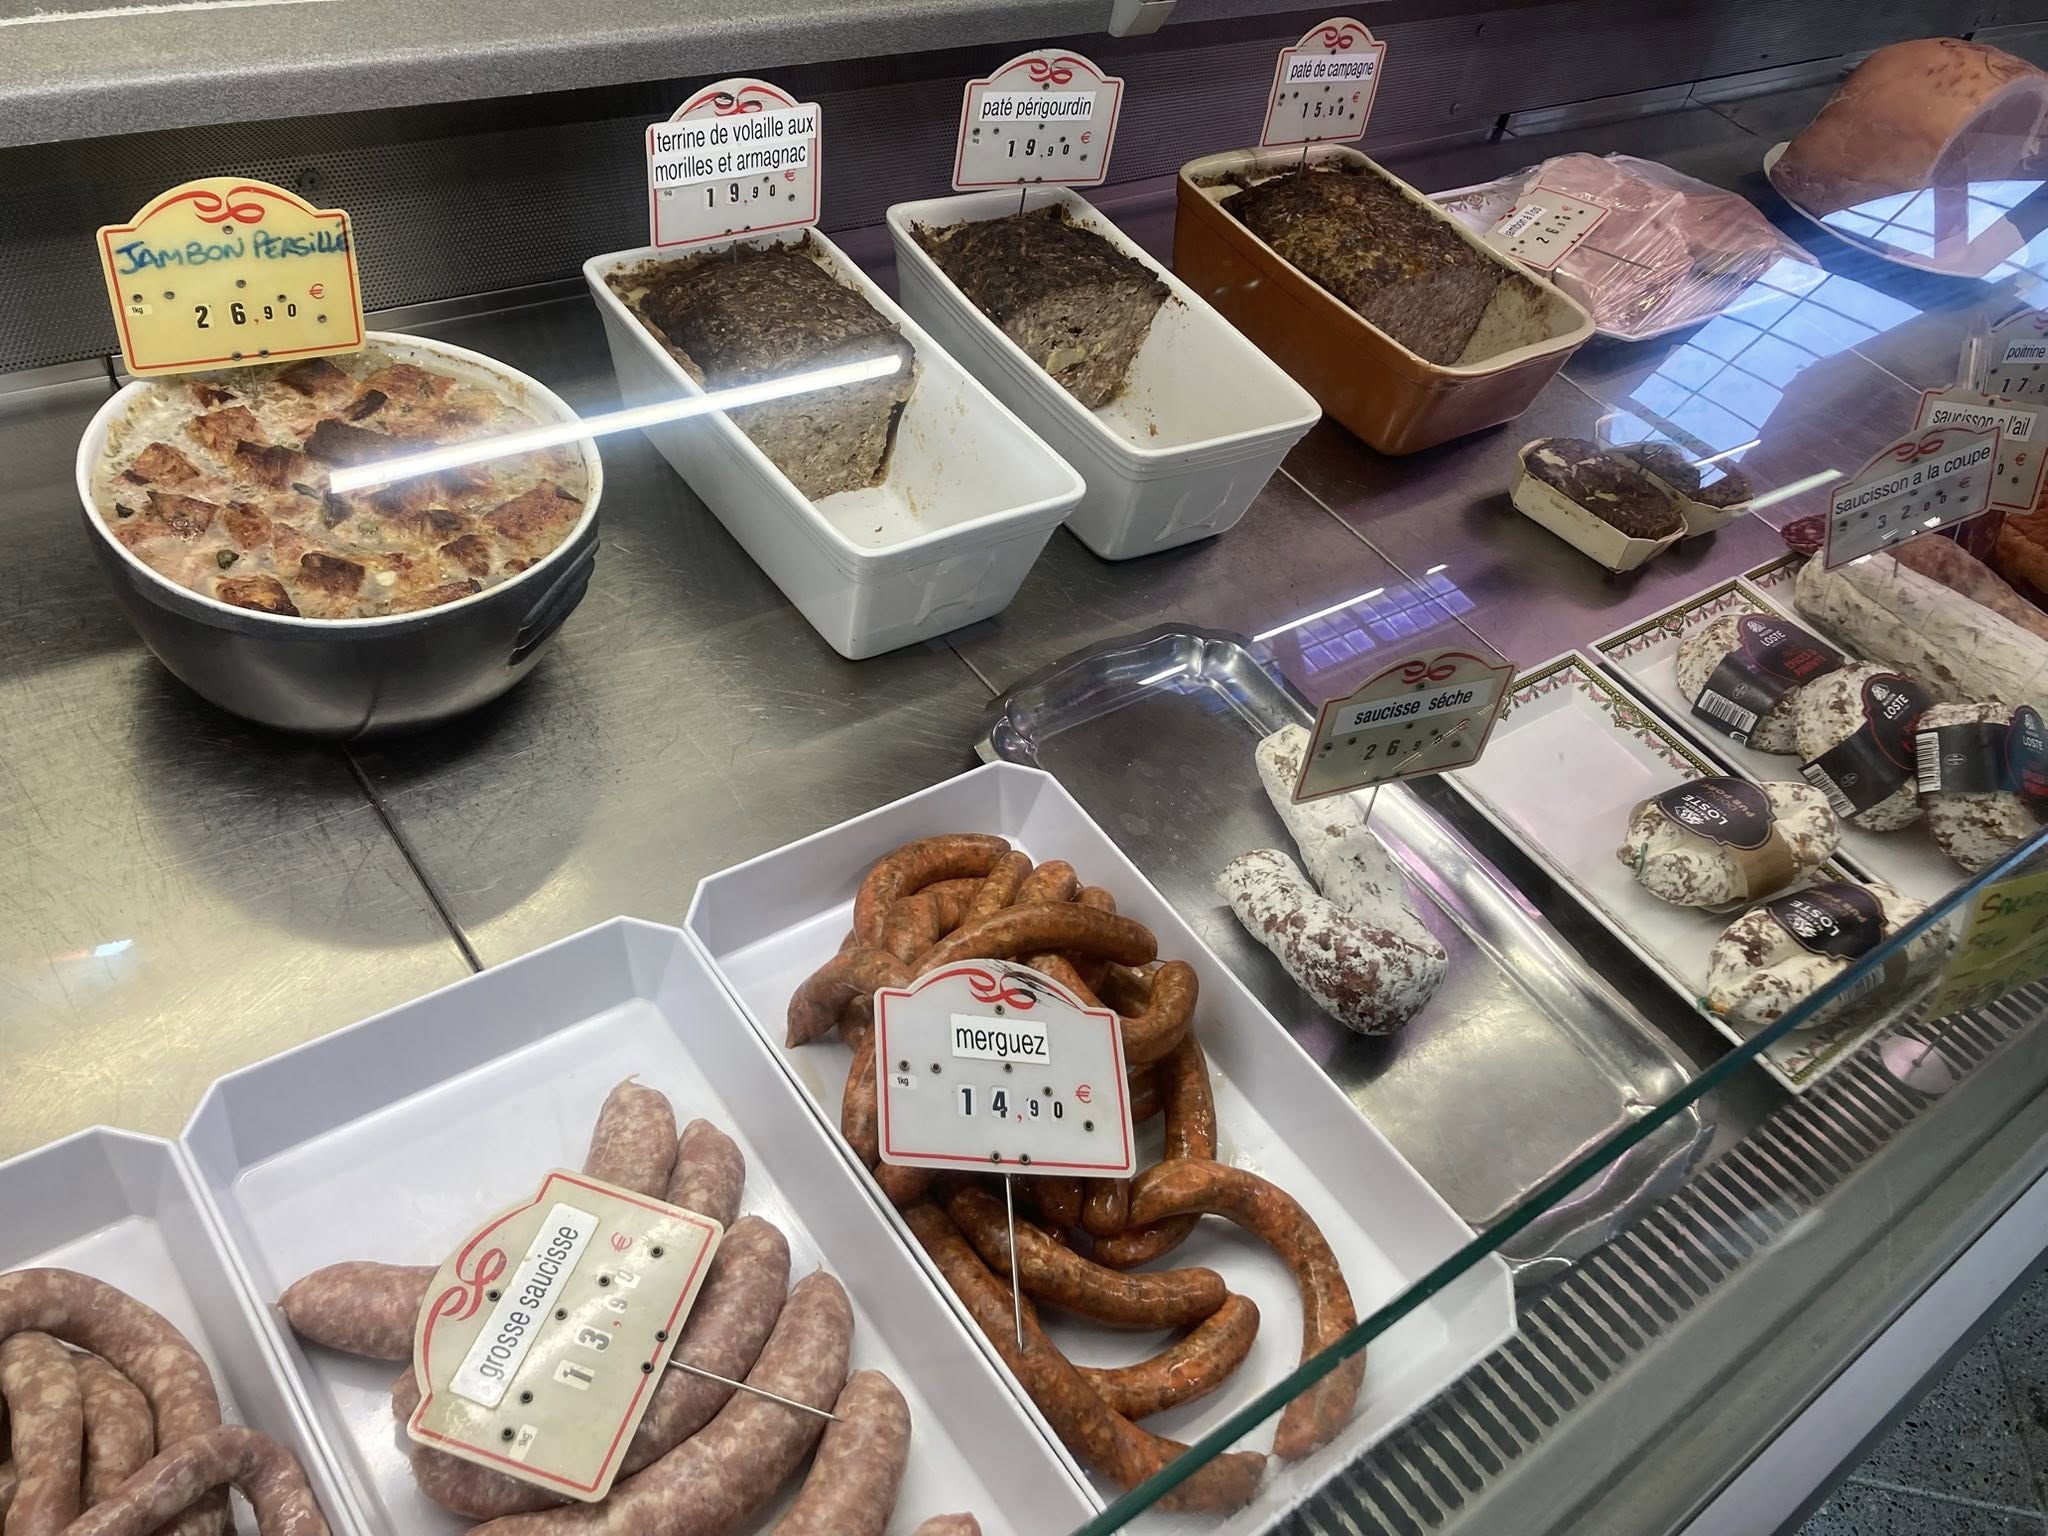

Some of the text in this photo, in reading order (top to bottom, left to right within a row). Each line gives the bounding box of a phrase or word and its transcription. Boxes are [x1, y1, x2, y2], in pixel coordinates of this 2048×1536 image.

[1290, 60, 1374, 81] paté de campagne
[982, 96, 1092, 119] paté périgourdin
[657, 116, 814, 153] terrine de volaille aux
[655, 145, 806, 182] morilles et armagnac
[115, 237, 244, 275] JAMBON
[2006, 344, 2046, 360] poitrine
[2006, 415, 2030, 436] l'ail
[1835, 476, 1909, 516] saucisson
[1927, 464, 1940, 479] la
[1943, 446, 1992, 474] coupe
[1760, 630, 1786, 647] LOSTE
[1354, 690, 1474, 726] saucisse séche
[1883, 694, 1909, 719] LOSTE
[2022, 736, 2043, 751] LOSTE
[1682, 794, 1728, 825] LOSTE
[1790, 900, 1840, 936] LOSTE
[956, 1028, 1047, 1057] merguez
[479, 1225, 579, 1381] grosse saucisse
